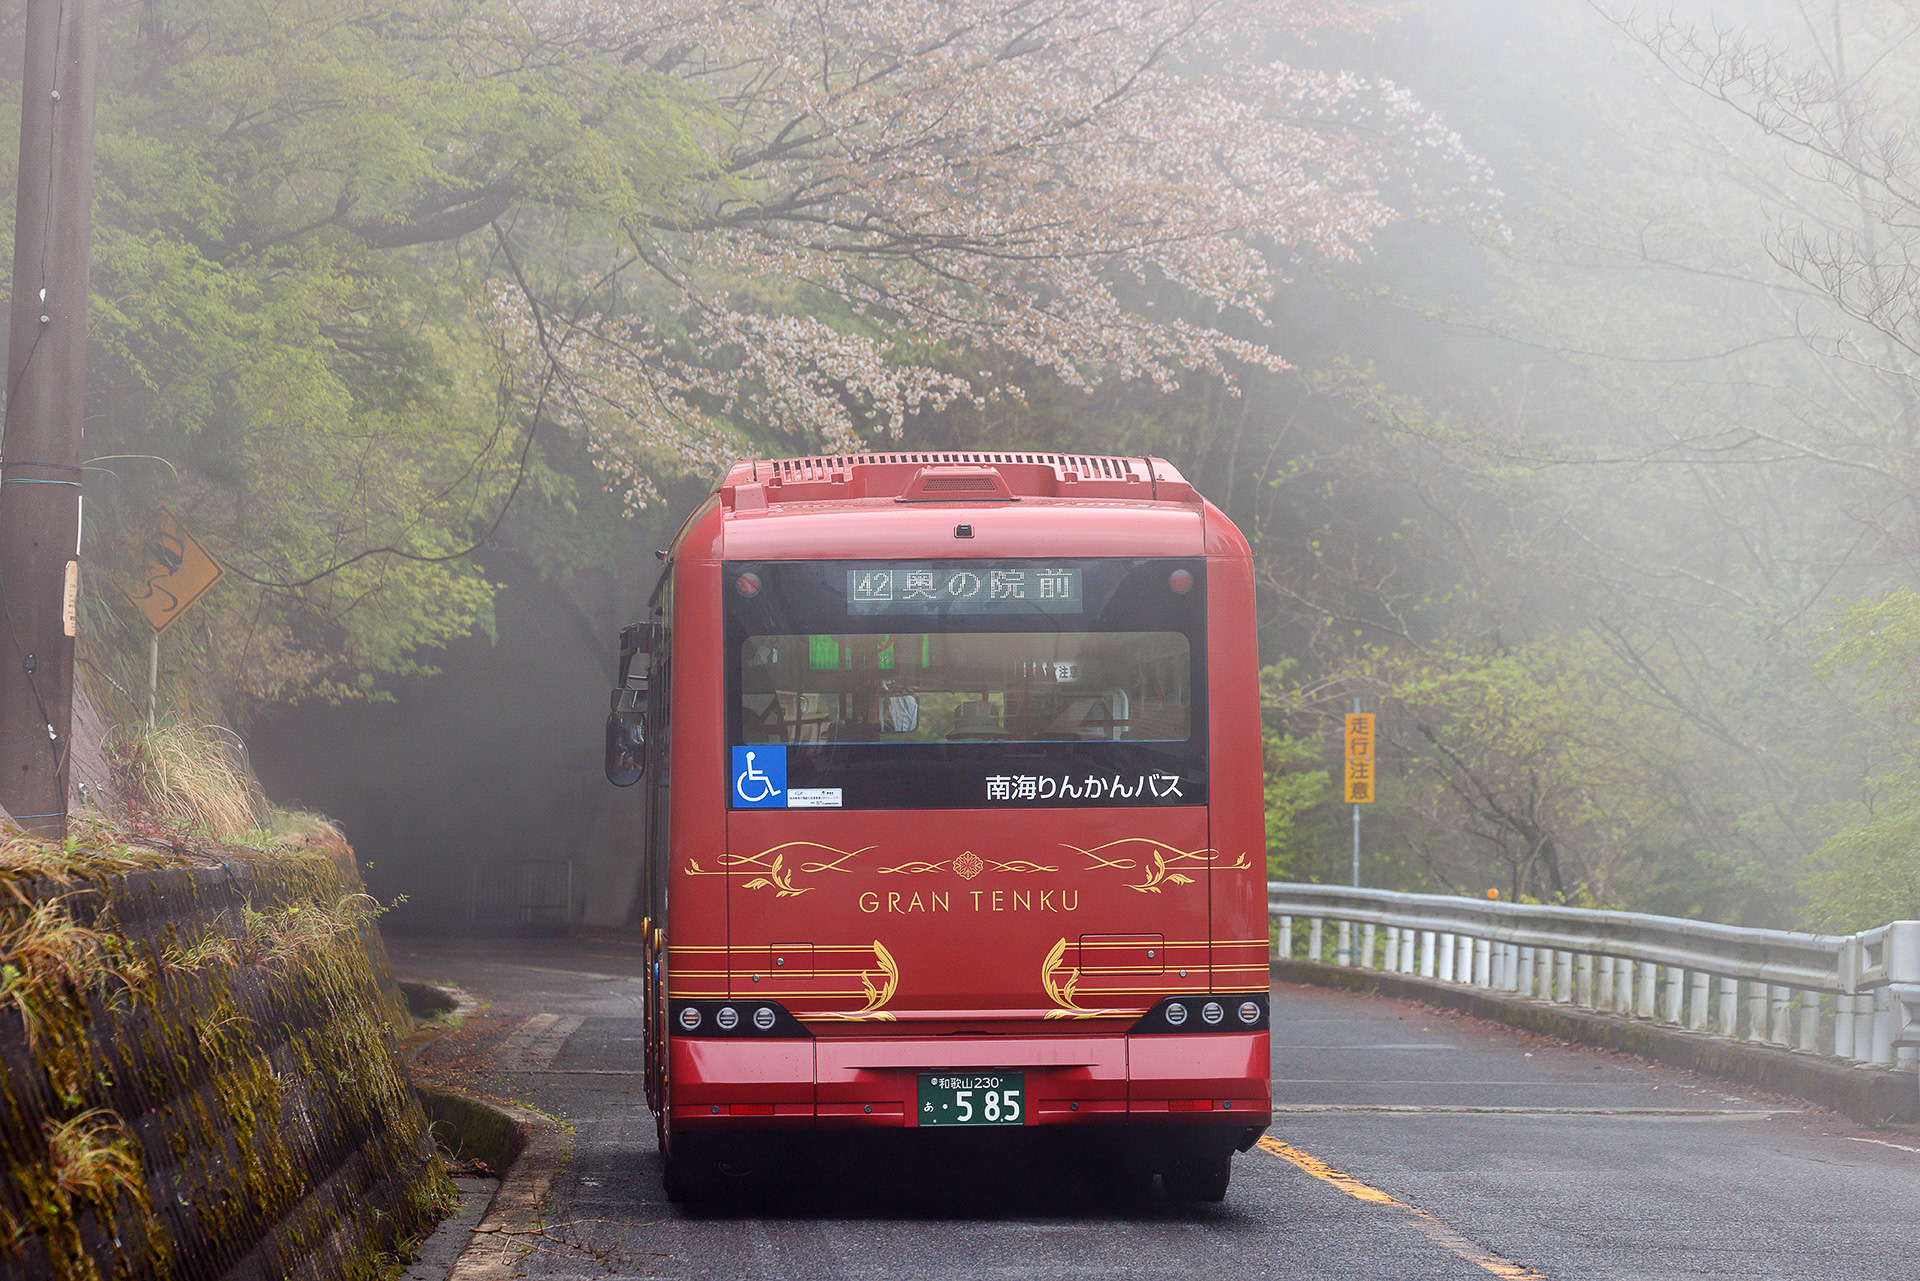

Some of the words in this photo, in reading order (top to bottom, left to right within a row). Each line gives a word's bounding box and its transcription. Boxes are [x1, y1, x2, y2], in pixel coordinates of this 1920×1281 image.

[857, 572, 889, 597] 42
[902, 569, 1073, 599] 奥の院前
[1350, 717, 1369, 800] 走行注意
[985, 774, 1184, 800] 南海りんかんバス
[859, 891, 949, 914] GRAN
[970, 890, 1078, 913] TENKU
